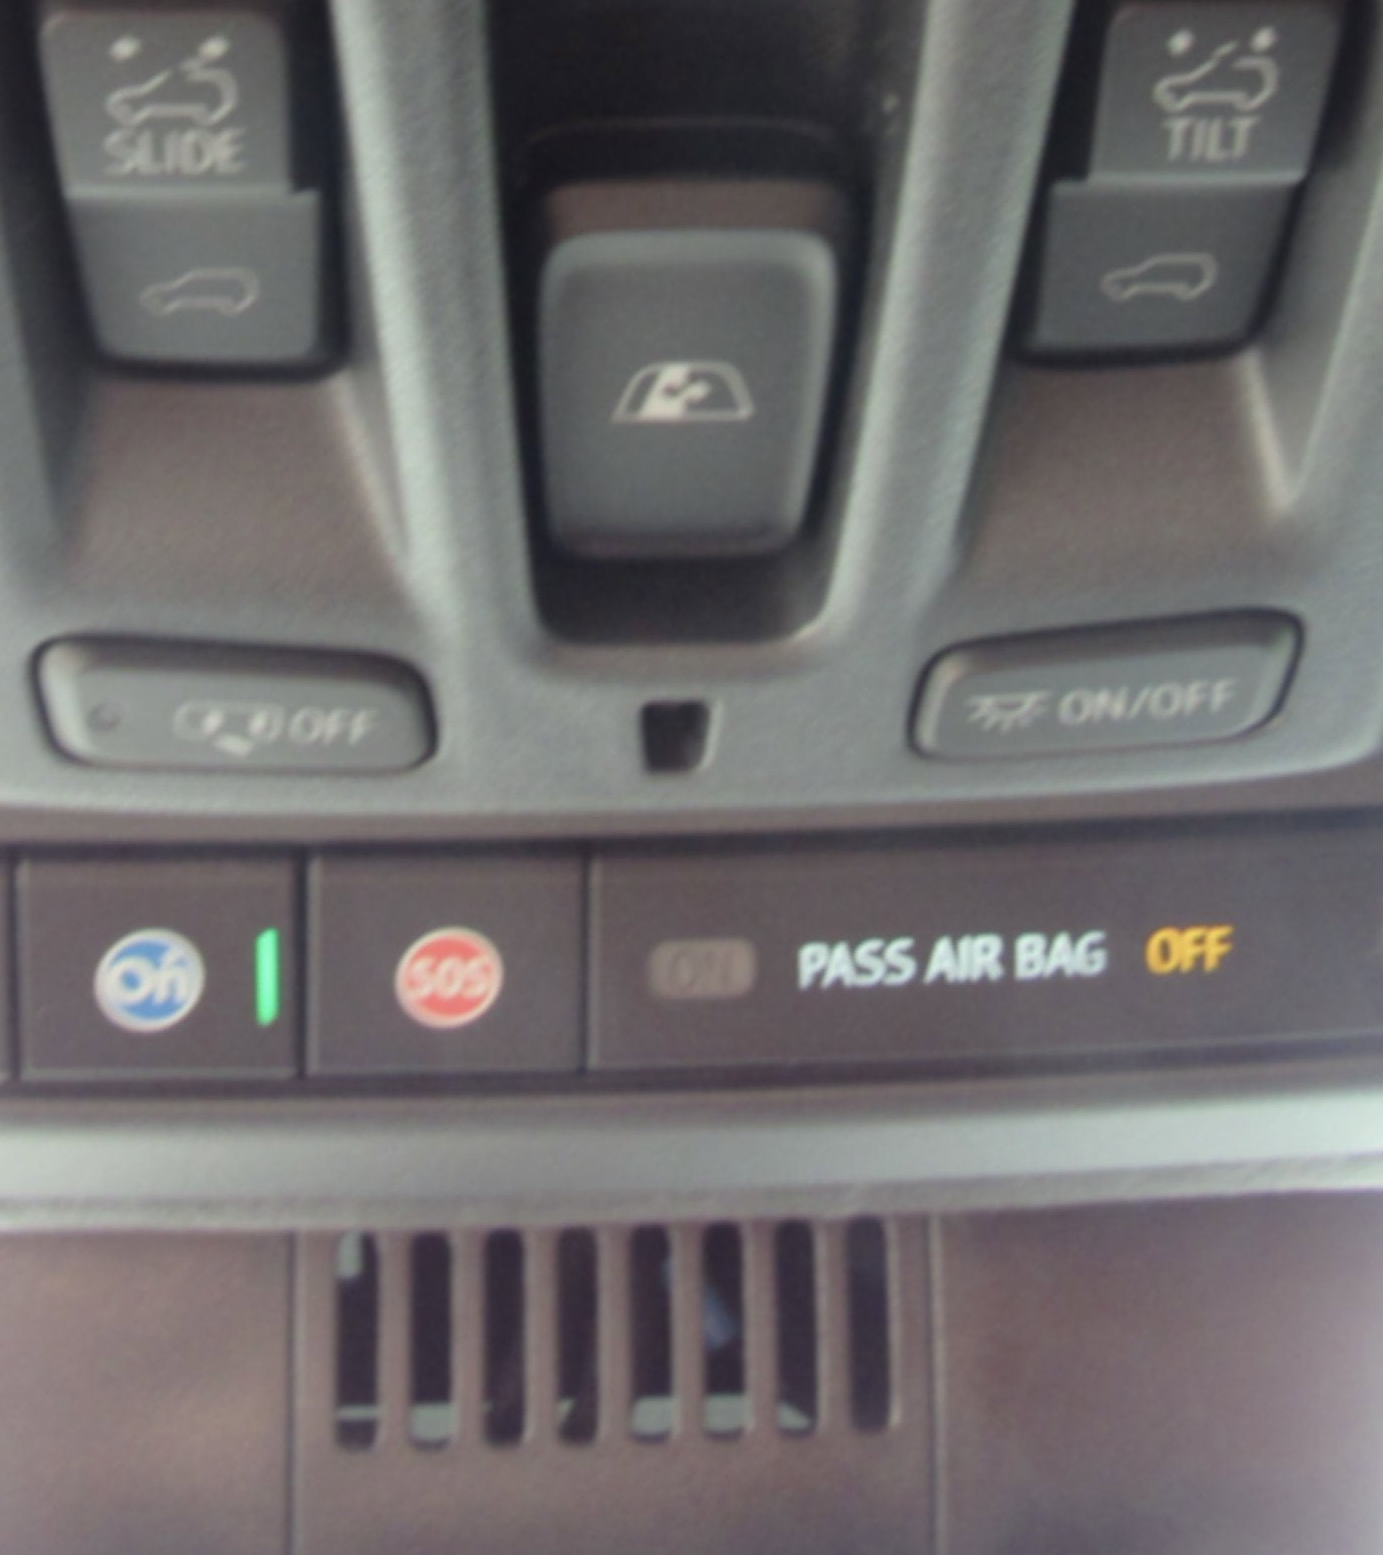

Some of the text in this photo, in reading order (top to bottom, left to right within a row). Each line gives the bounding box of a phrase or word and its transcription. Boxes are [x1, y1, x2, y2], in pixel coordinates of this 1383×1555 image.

[104, 127, 248, 176] SLIDE
[1162, 116, 1259, 162] TILT
[1057, 677, 1238, 725] ON/OFF
[288, 705, 378, 745] OFF
[405, 953, 492, 999] SOS
[797, 937, 917, 991] PASS
[923, 933, 1006, 986] AIR
[1014, 929, 1108, 981] BAG
[1145, 923, 1234, 976] OFF
